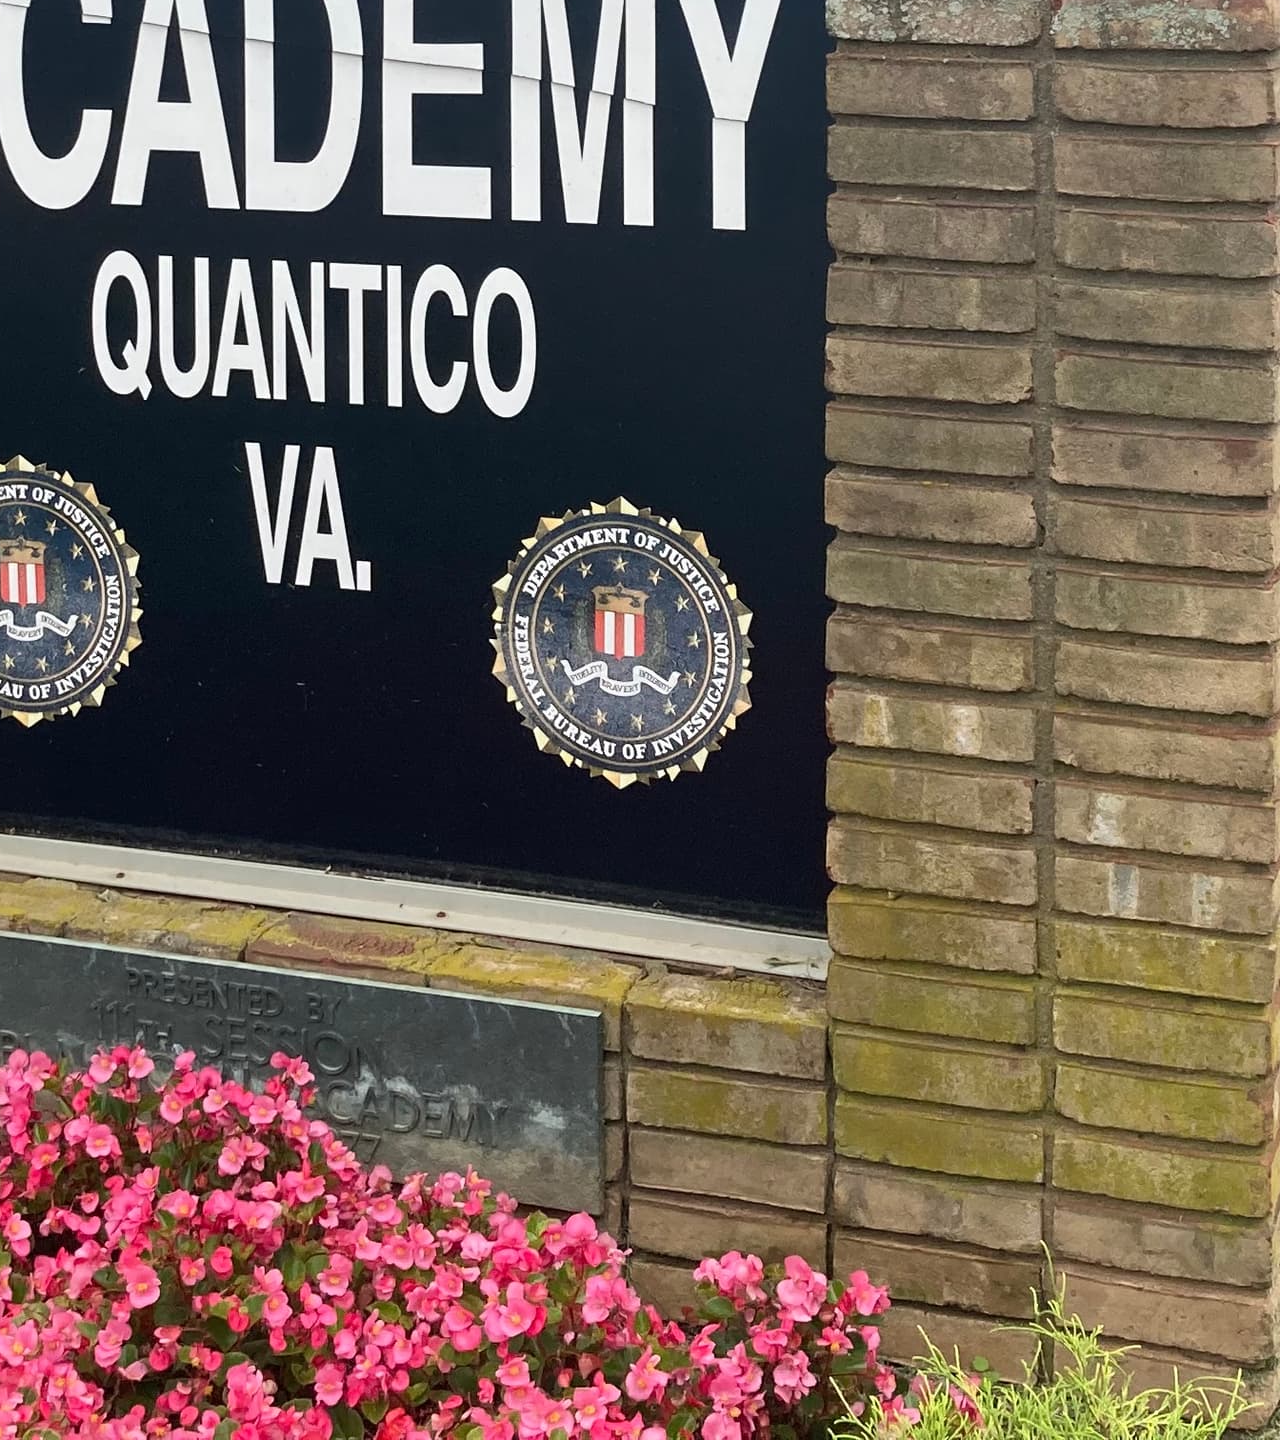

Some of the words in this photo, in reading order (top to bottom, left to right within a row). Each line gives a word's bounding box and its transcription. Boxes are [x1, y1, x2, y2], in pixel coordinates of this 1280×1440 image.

[92, 250, 537, 418] QUANTICO
[32, 487, 56, 503] OF
[55, 493, 111, 559] JUSTICE
[245, 442, 372, 591] VA.
[522, 528, 630, 598] DEPARTMENT
[634, 532, 660, 550] OF
[660, 539, 720, 614] JUSTICE
[29, 682, 52, 700] OF
[55, 574, 121, 696] INVESTIGATION
[514, 613, 545, 705] FEDERAL
[543, 702, 616, 758] BUREAU
[622, 743, 646, 760] OF
[652, 631, 730, 757] INVESTIGATION
[126, 966, 283, 1018] PRESENTED
[306, 991, 343, 1025] BY
[325, 1076, 510, 1148] CADEMY
